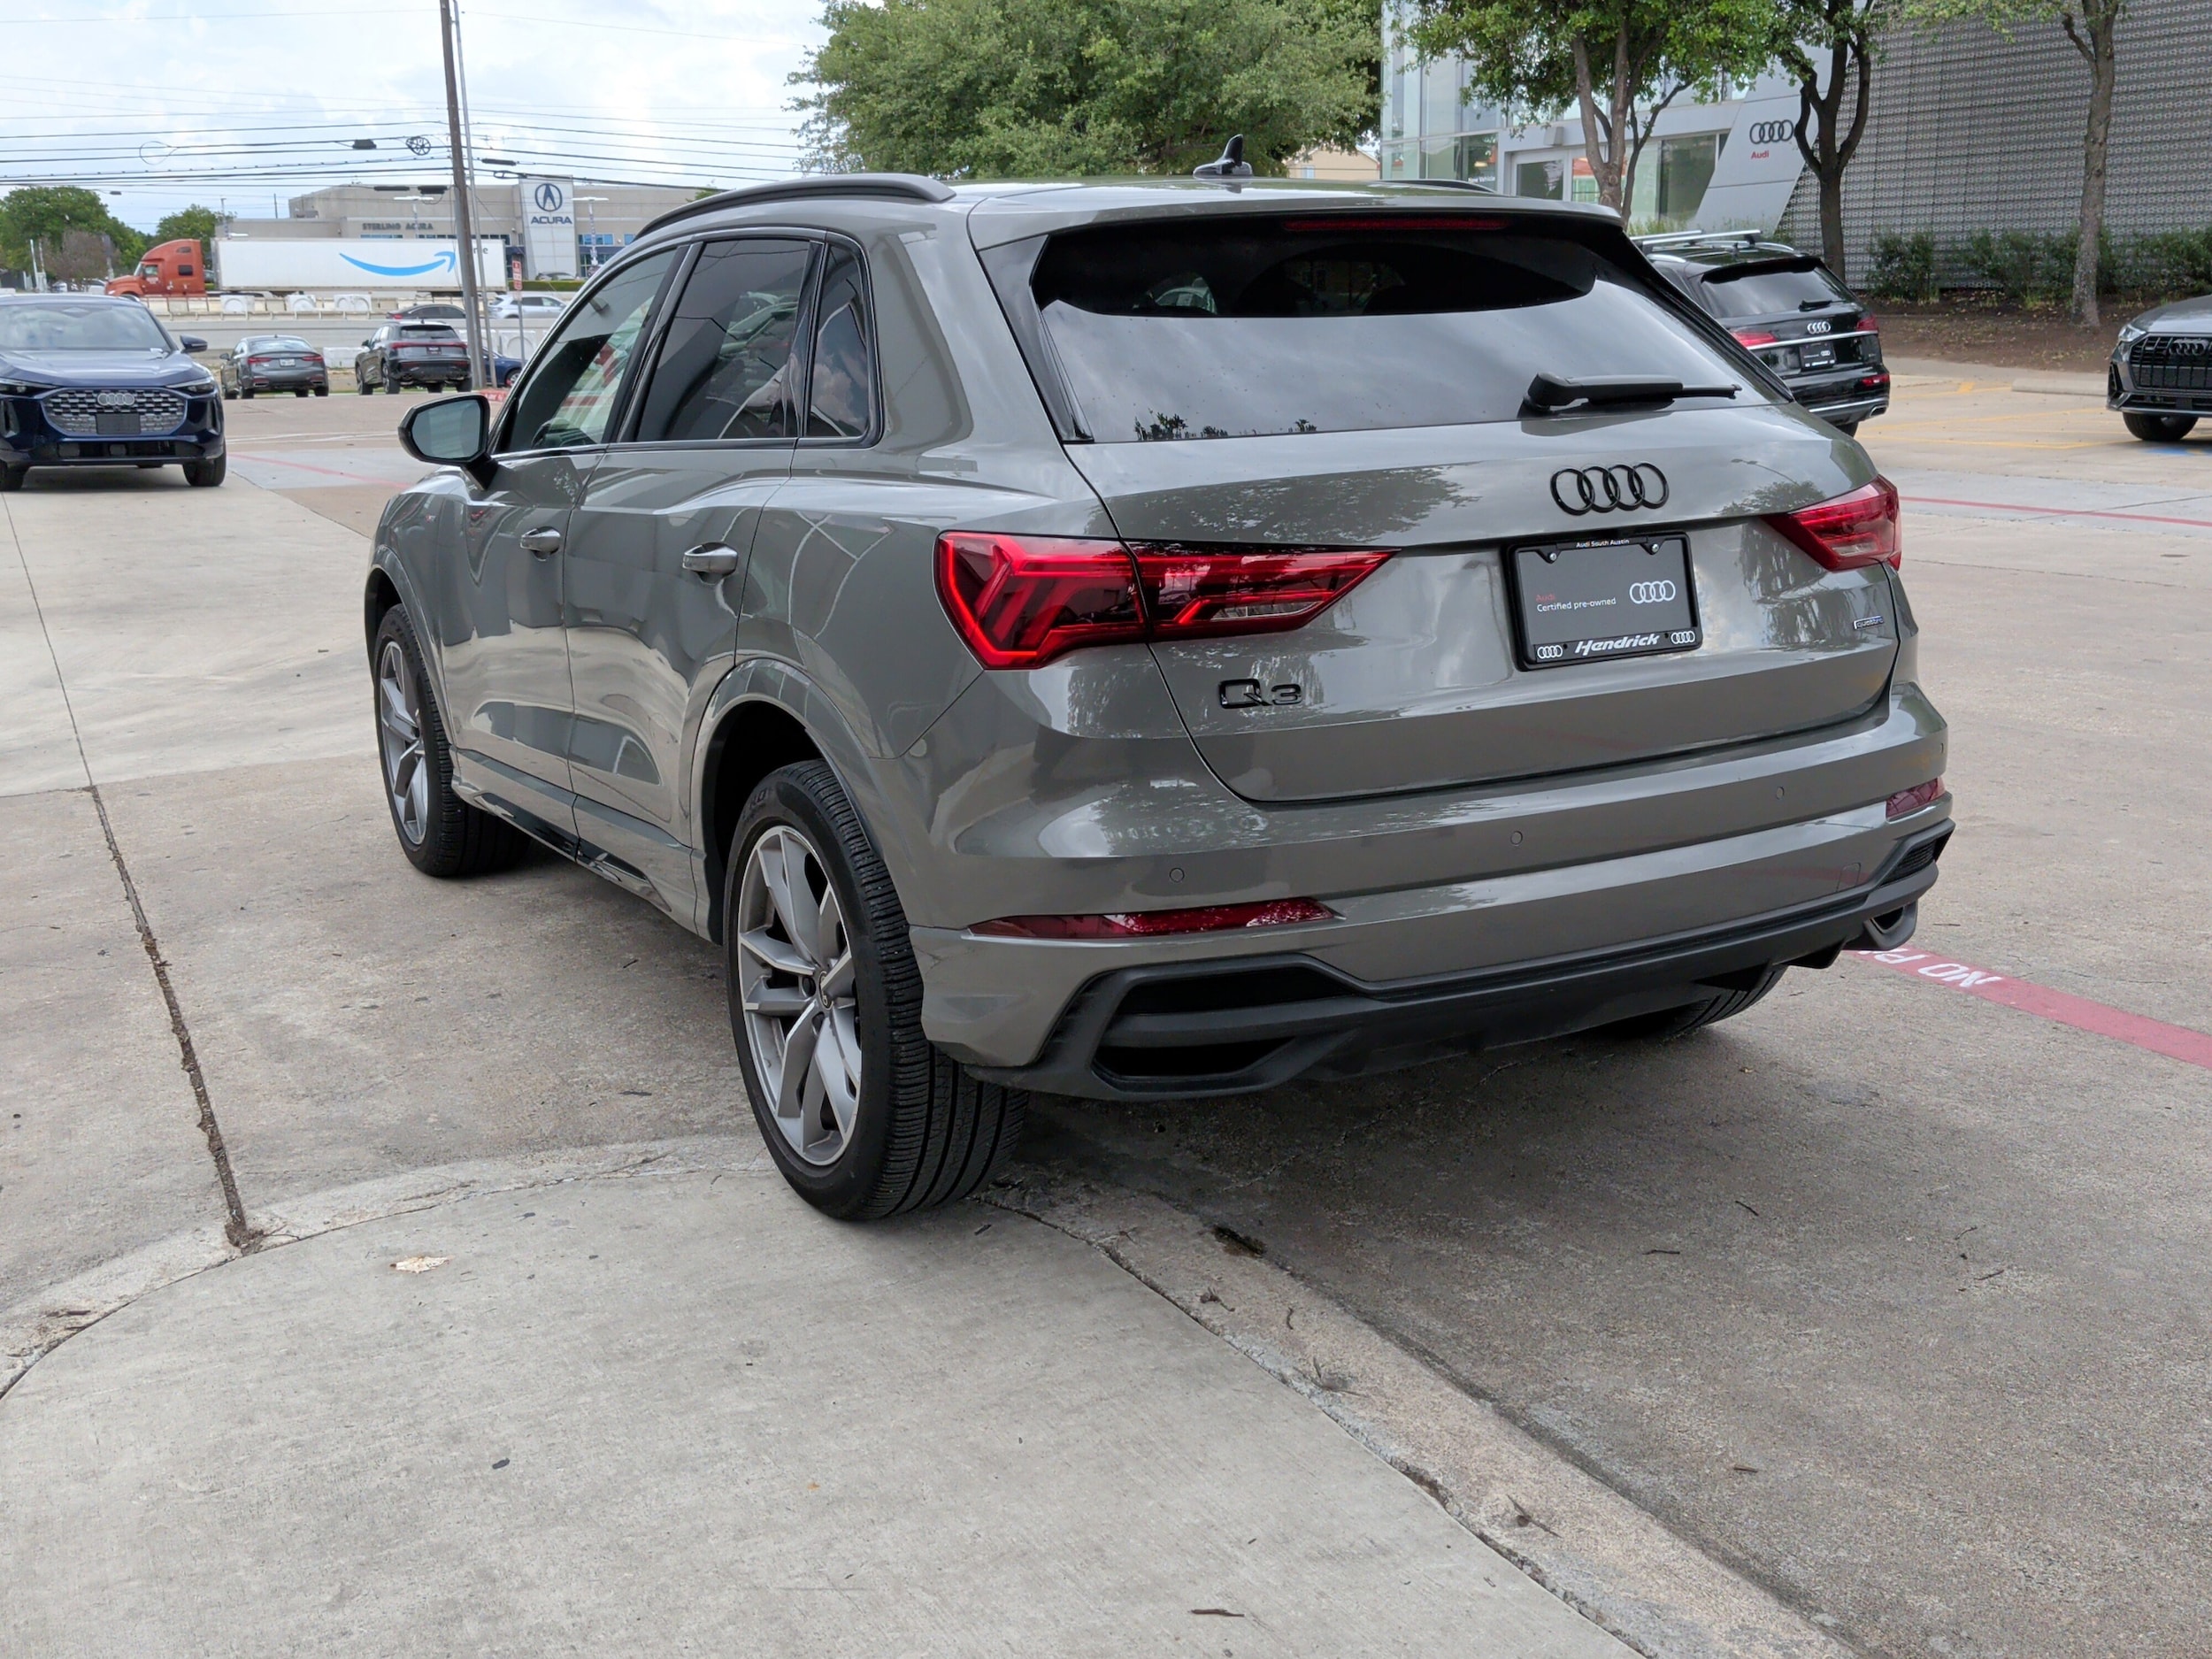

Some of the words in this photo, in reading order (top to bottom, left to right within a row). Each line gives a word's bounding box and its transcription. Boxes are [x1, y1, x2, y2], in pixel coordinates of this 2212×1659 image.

[1751, 150, 1770, 159] Audi
[531, 216, 572, 225] ACURA
[1537, 602, 1572, 612] Certified
[1574, 597, 1617, 611] pre-owned
[1575, 634, 1660, 656] Hendrick
[1218, 678, 1303, 710] Q3
[1917, 963, 2003, 987] NO
